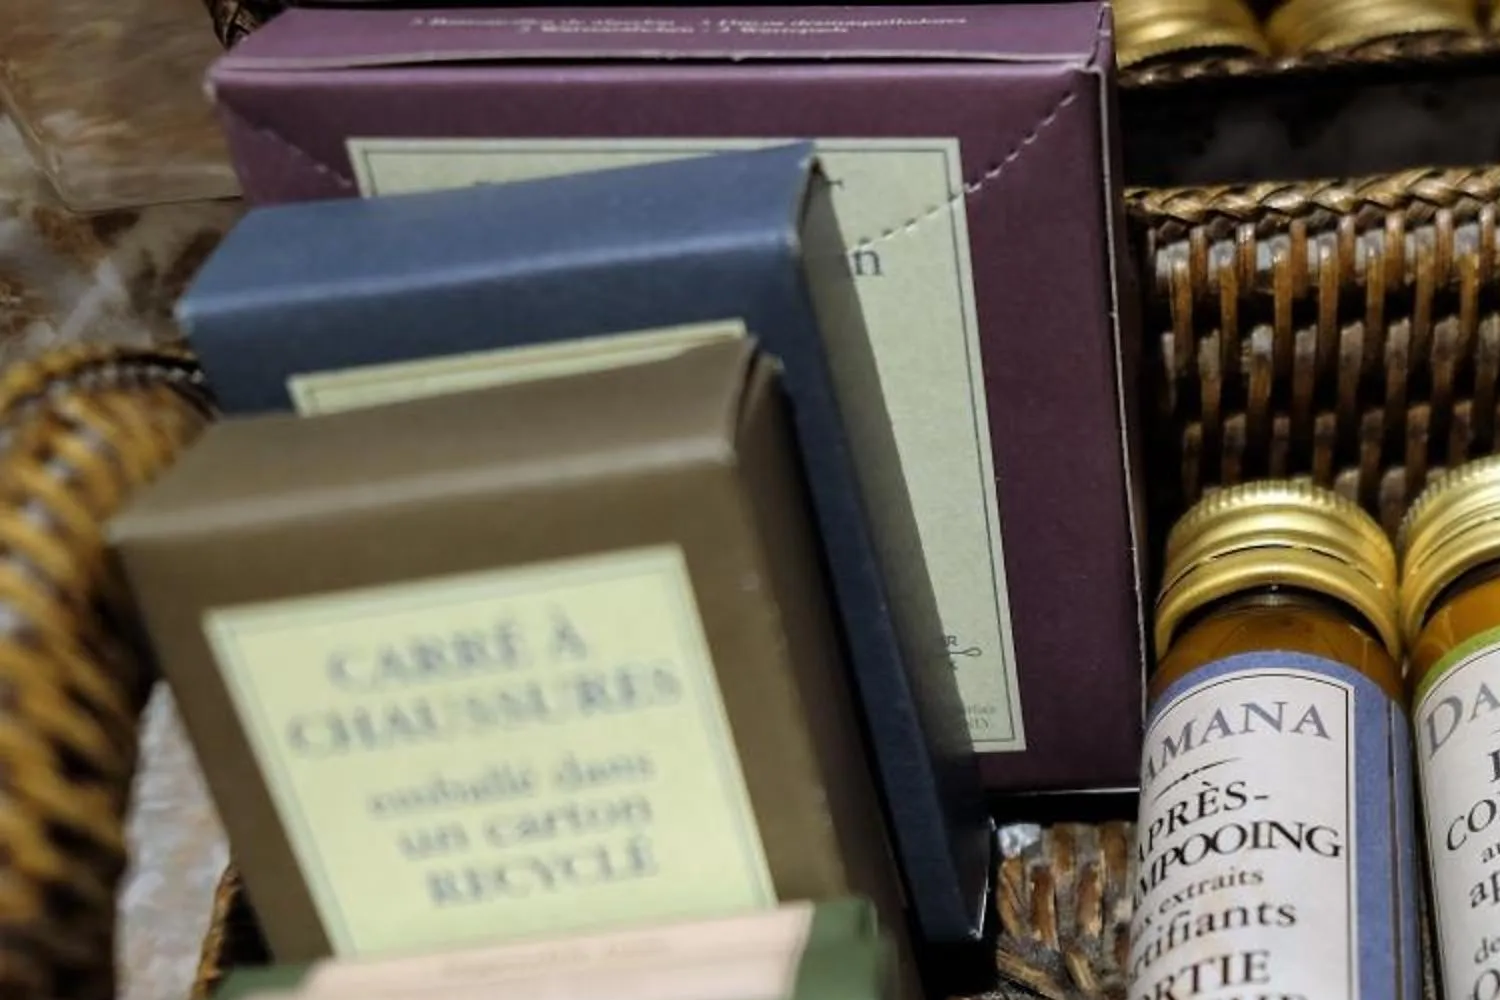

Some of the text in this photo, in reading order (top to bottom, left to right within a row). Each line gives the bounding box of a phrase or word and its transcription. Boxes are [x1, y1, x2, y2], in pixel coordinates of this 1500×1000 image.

[1148, 701, 1332, 780] MANA
[1138, 820, 1344, 900] MPOOING
[1159, 865, 1265, 915] extraits
